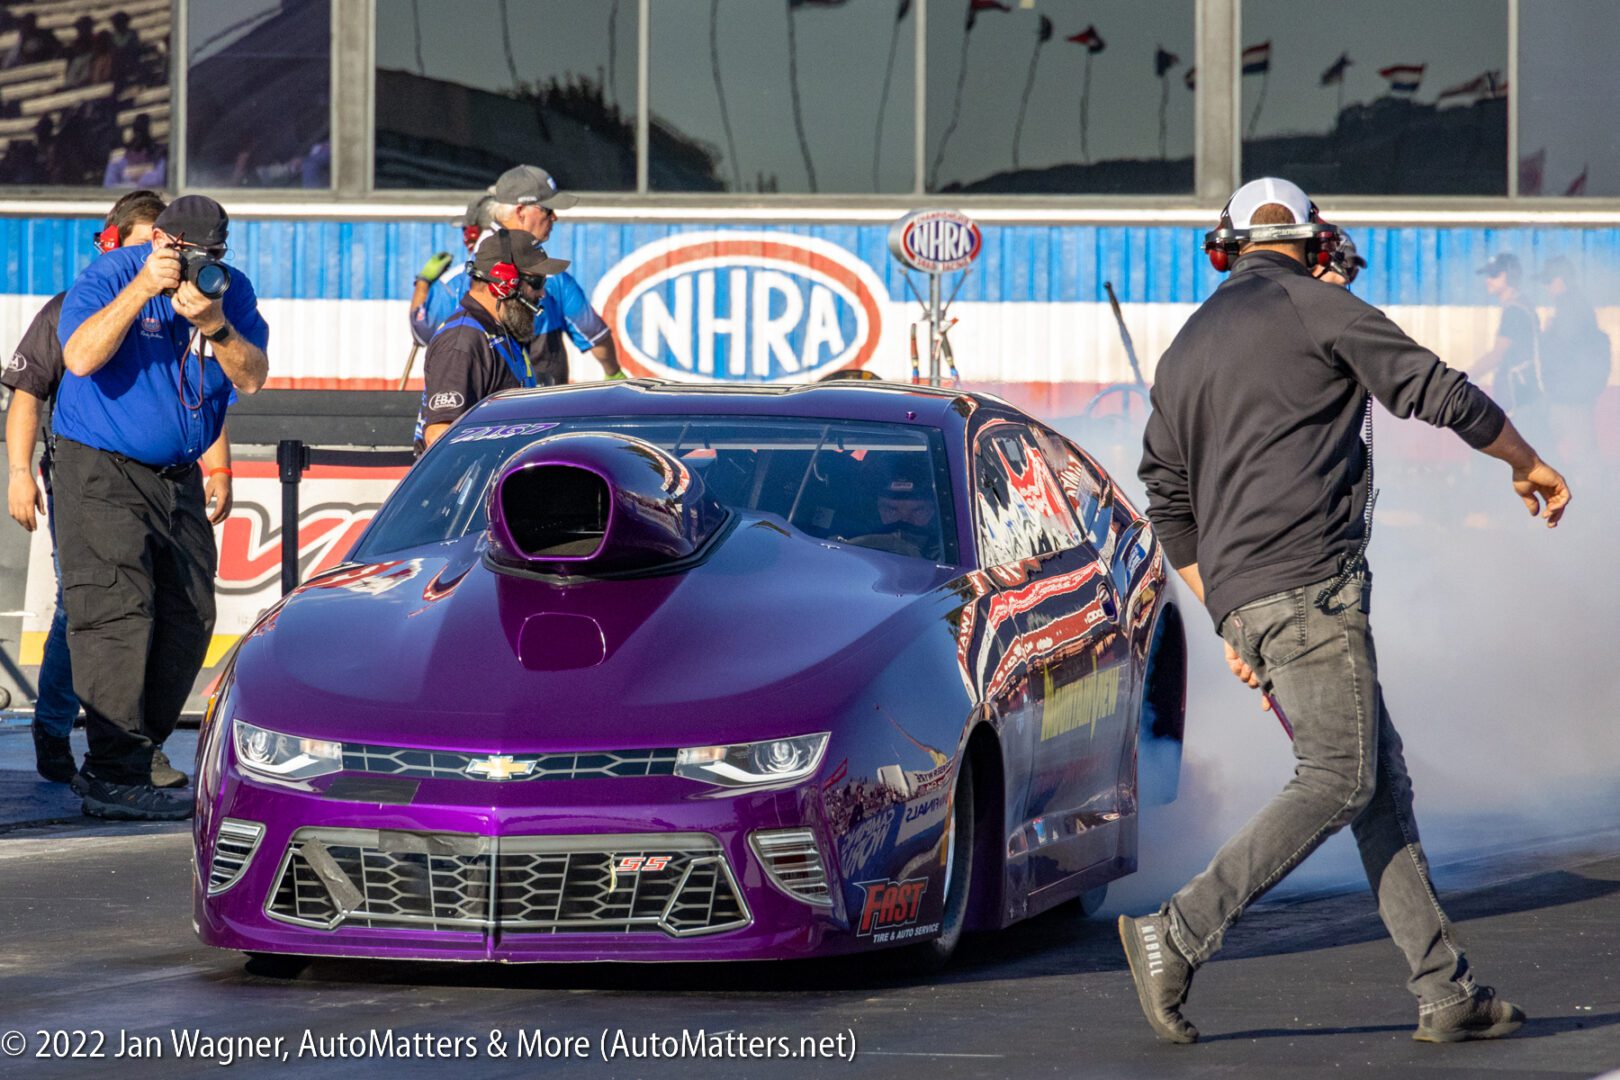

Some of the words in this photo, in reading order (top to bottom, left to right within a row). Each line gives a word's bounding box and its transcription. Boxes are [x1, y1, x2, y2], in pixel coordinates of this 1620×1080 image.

[913, 221, 972, 261] NHRA
[642, 268, 845, 376] NHRA
[616, 856, 672, 871] SS
[859, 880, 926, 932] FAST
[873, 932, 889, 943] TIRE
[889, 931, 896, 941] &
[896, 928, 914, 940] AUTO
[914, 923, 940, 936] SERVICE
[1141, 925, 1164, 977] NOBULL
